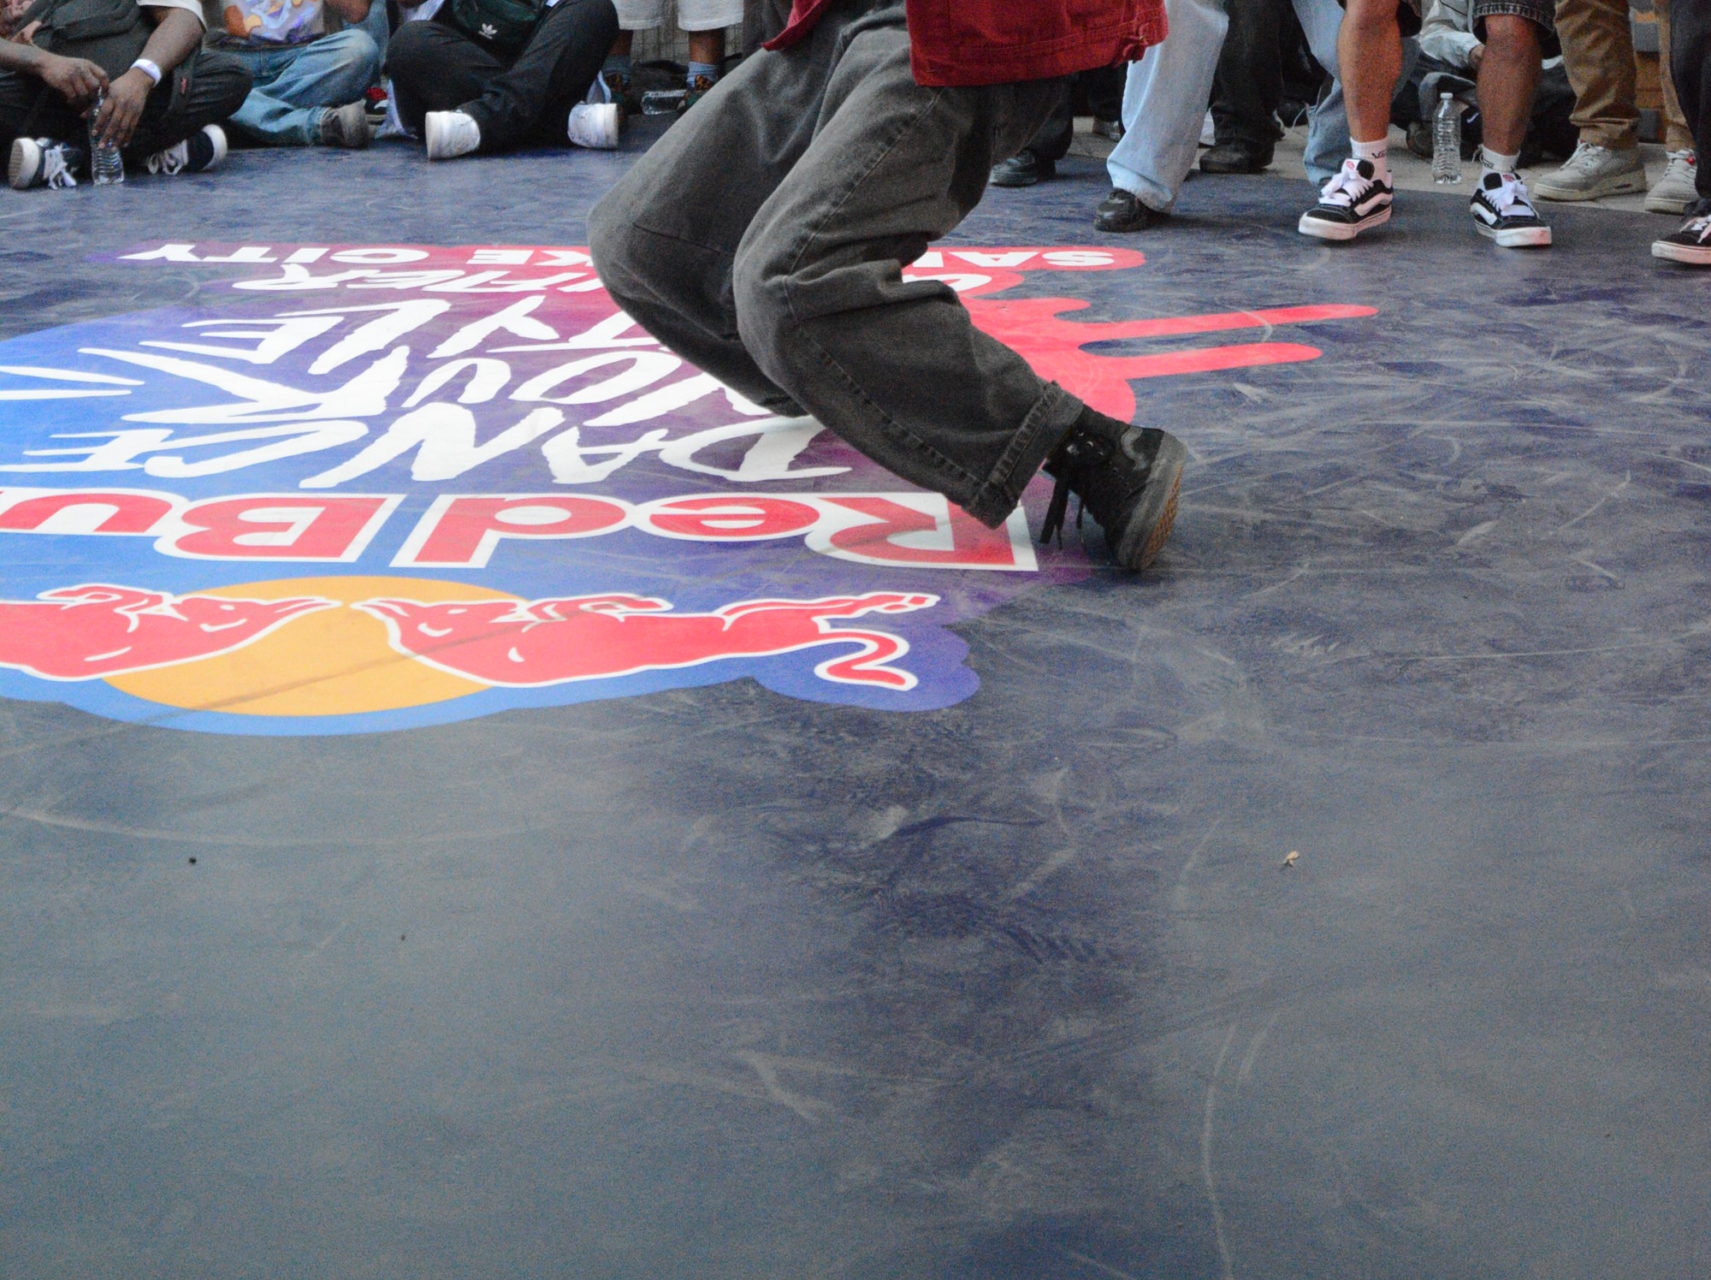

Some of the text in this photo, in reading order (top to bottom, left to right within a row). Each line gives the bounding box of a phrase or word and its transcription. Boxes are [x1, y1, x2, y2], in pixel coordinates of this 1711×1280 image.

[118, 243, 1115, 268] SAL KE CITY
[139, 295, 676, 374] TYLE
[78, 346, 771, 426] YOUR
[0, 402, 853, 488] DANCE
[0, 492, 1025, 569] Red Bu
